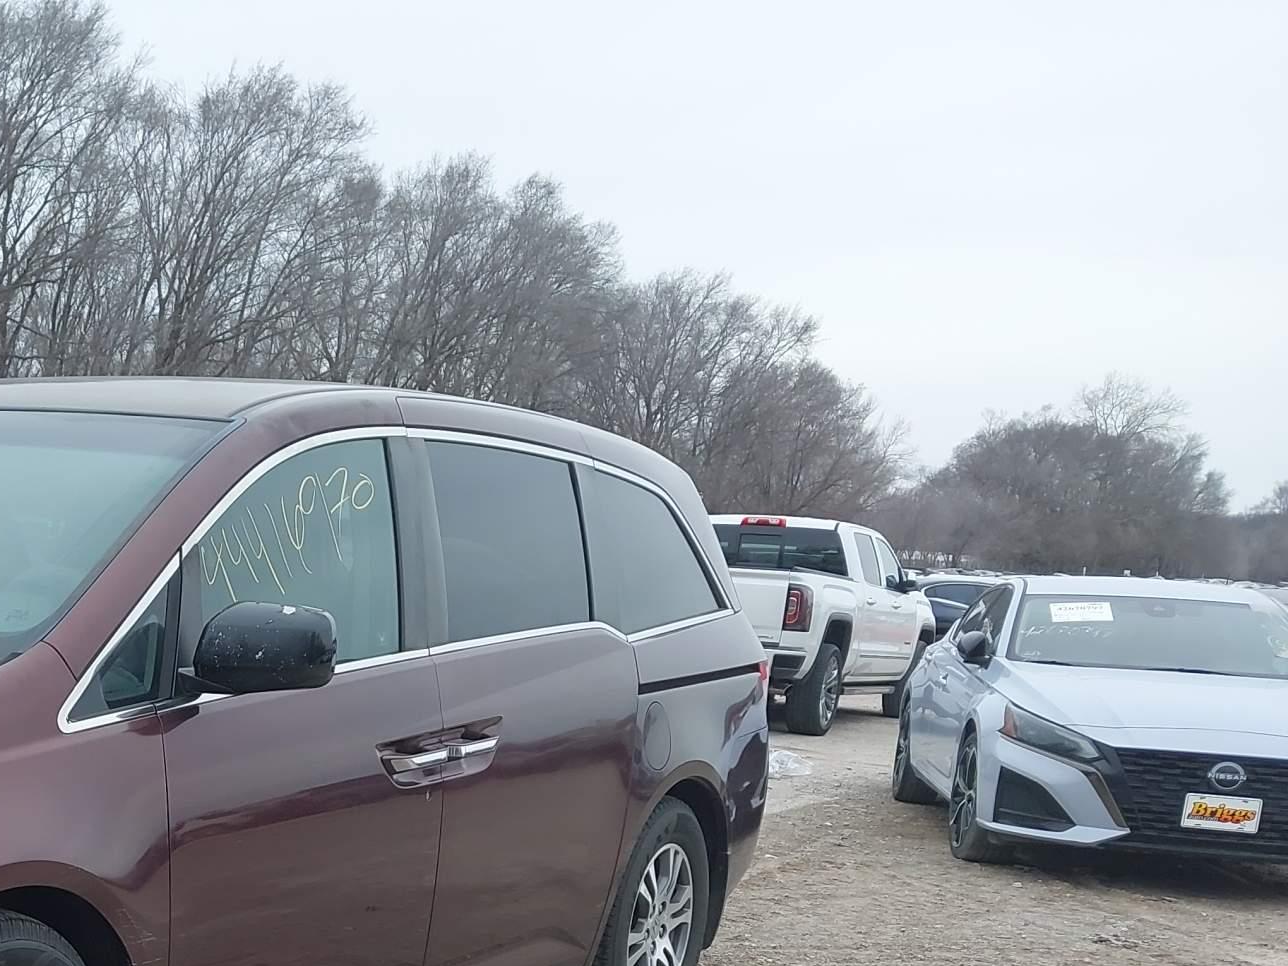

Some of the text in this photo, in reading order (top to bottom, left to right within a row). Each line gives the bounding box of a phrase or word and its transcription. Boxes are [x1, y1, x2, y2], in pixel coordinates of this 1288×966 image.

[200, 466, 376, 602] 44416970
[1207, 772, 1248, 781] NISSAN
[1192, 802, 1256, 824] Briggs
